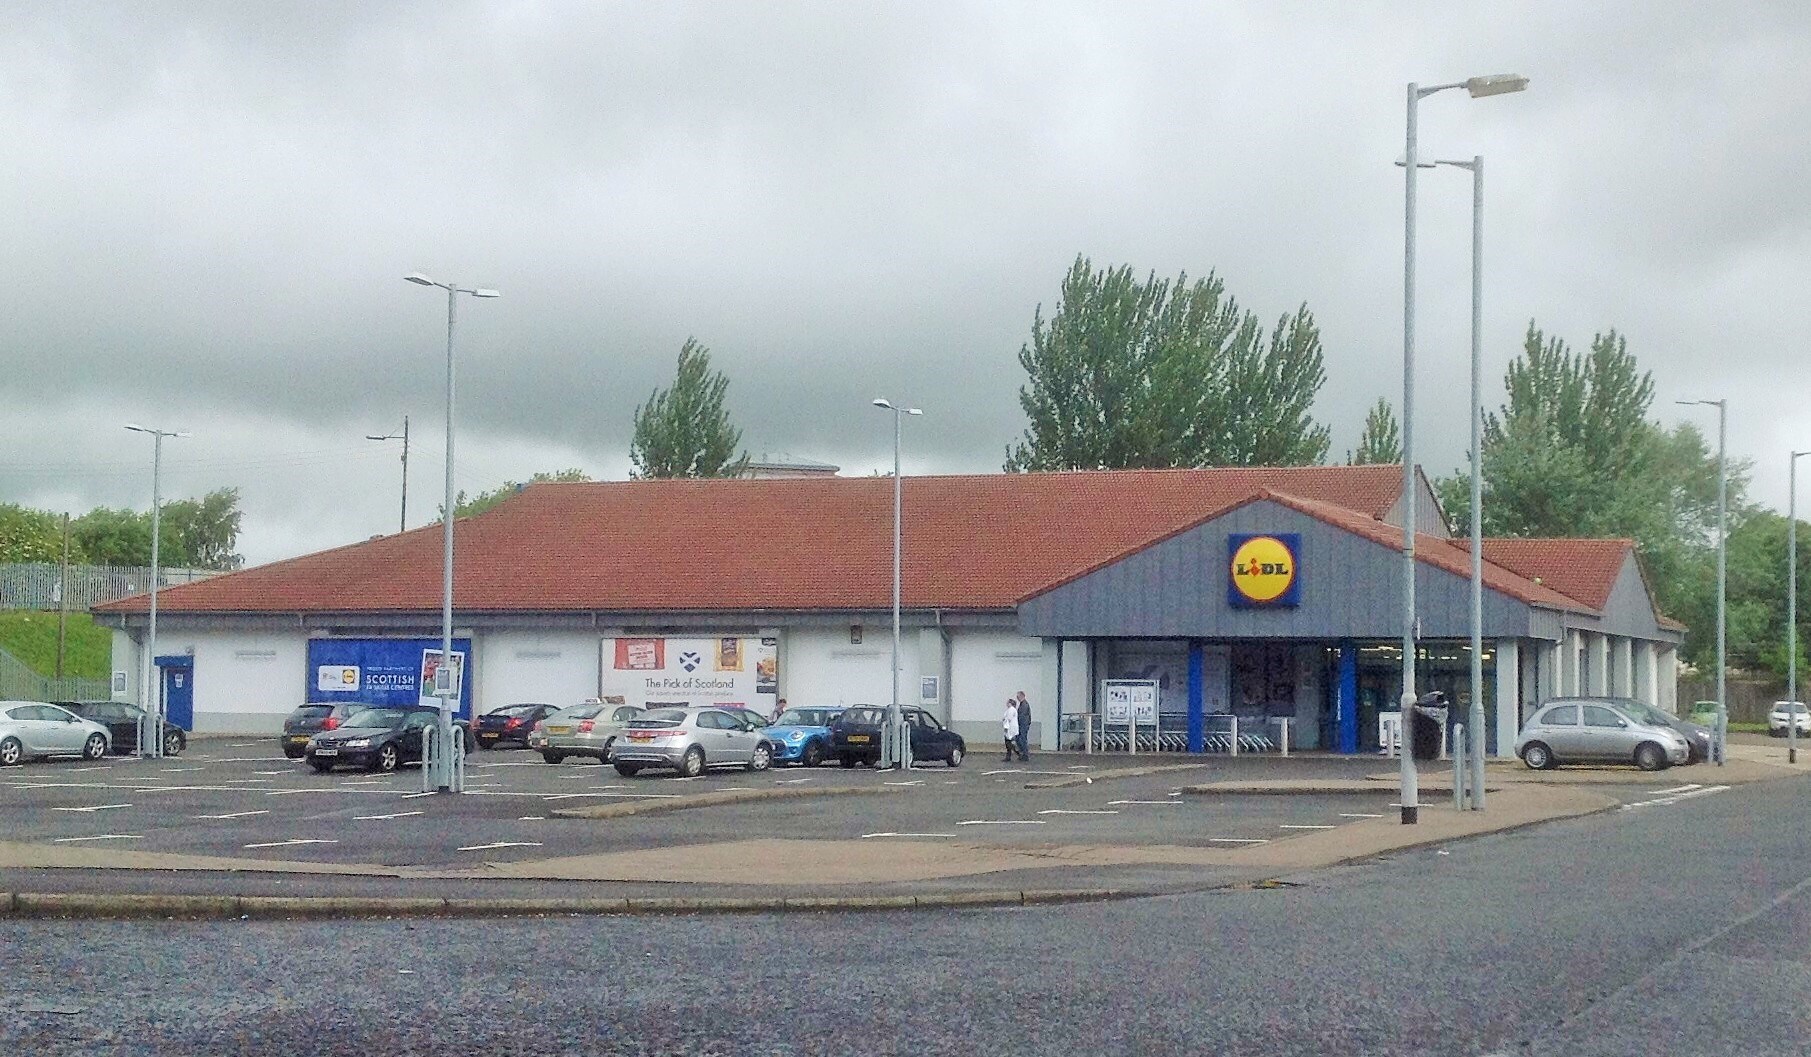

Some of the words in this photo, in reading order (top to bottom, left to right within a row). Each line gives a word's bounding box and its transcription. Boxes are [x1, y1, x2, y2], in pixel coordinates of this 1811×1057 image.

[366, 674, 415, 684] SCOTTISH
[645, 677, 661, 688] The
[663, 677, 681, 689] Pick
[683, 677, 693, 688] of
[695, 677, 734, 689] Scotland
